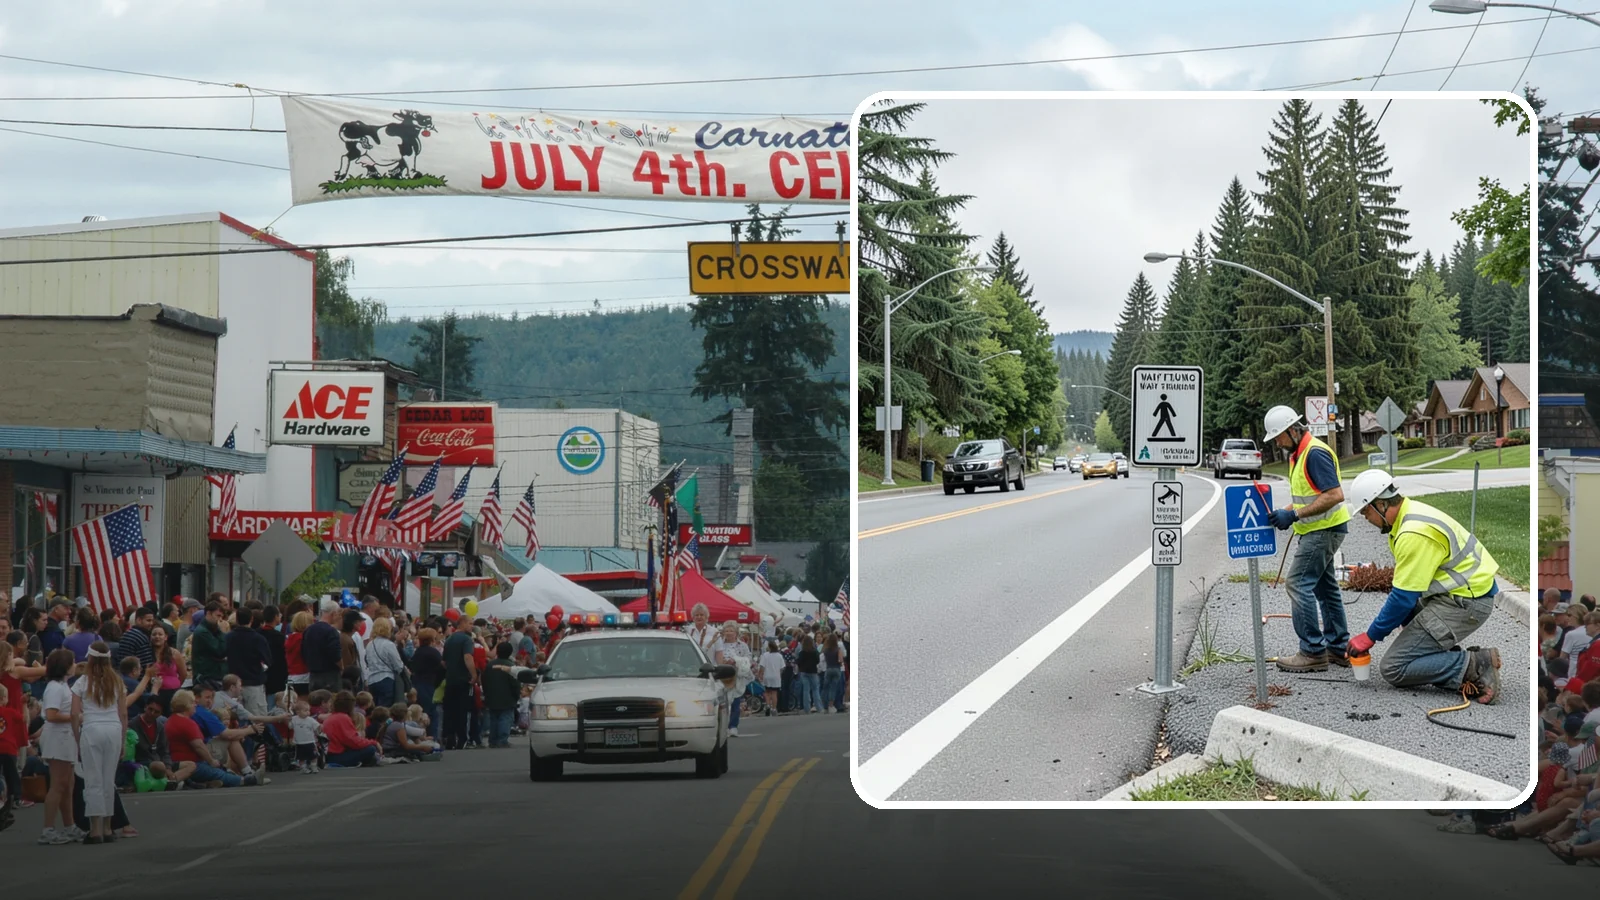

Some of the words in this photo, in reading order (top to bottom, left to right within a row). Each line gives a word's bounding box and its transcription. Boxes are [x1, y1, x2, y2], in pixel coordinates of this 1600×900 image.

[481, 140, 605, 192] JULY
[632, 150, 747, 198] 4th.
[697, 254, 850, 280] CROSSWA
[282, 379, 374, 420] ACE
[405, 409, 453, 422] CEDAR
[283, 421, 371, 436] Hardware
[416, 427, 477, 447] Coca-Cola
[353, 467, 385, 480] Simpl
[96, 484, 124, 495] Vincent
[126, 485, 136, 495] de
[137, 486, 155, 496] Paul
[699, 535, 731, 544] GLASS
